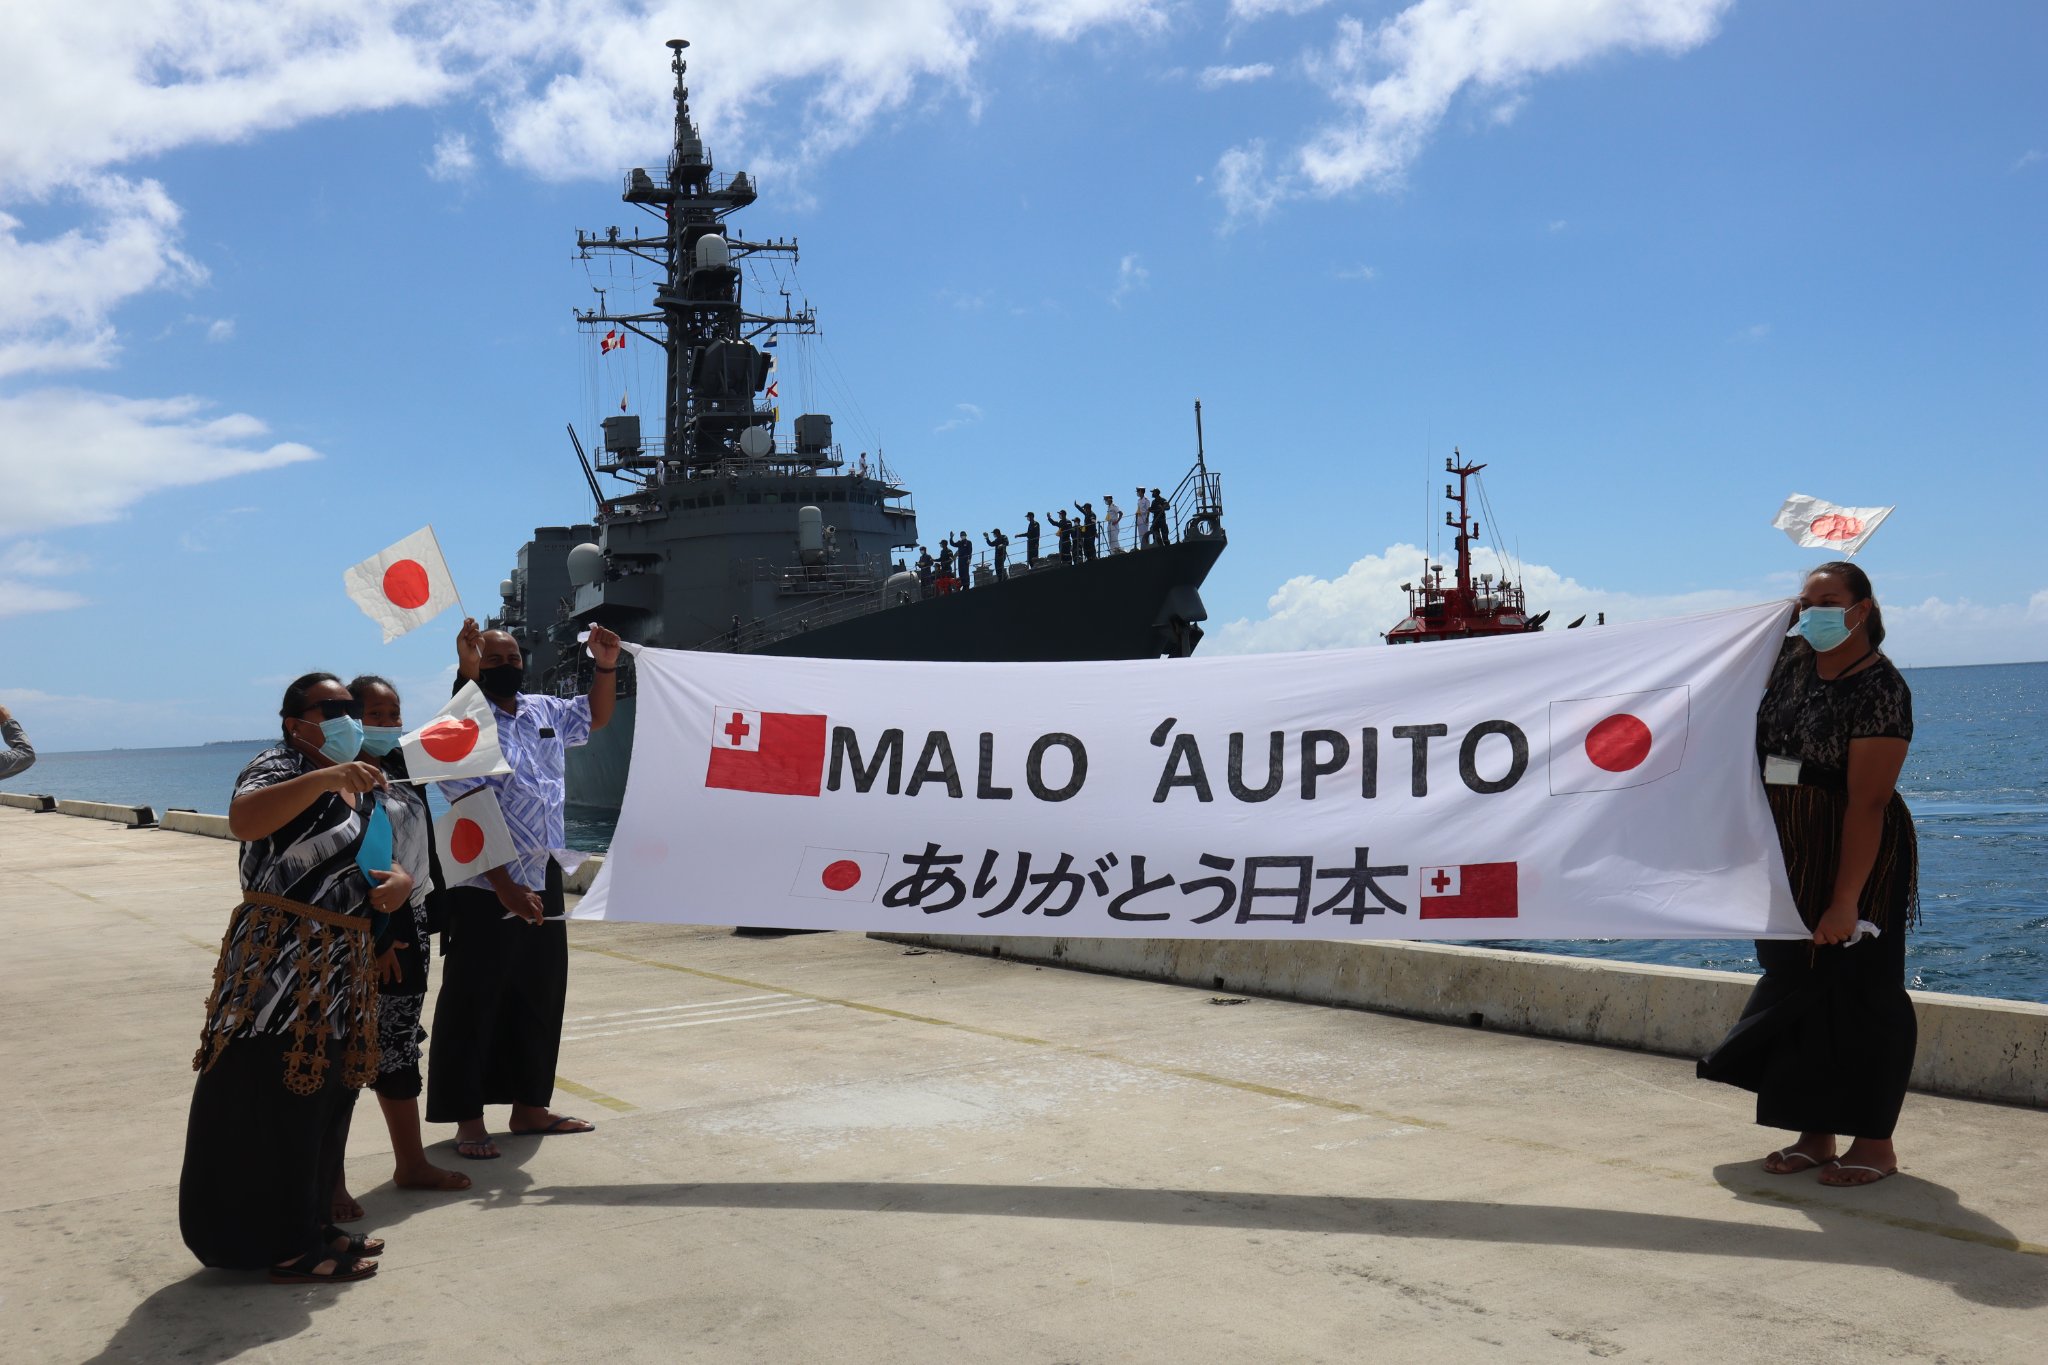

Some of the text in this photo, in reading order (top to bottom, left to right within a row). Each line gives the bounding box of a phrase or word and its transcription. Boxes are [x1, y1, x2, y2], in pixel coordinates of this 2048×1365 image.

[826, 725, 1088, 803] MALO
[882, 842, 1409, 925] ありがとう日本
